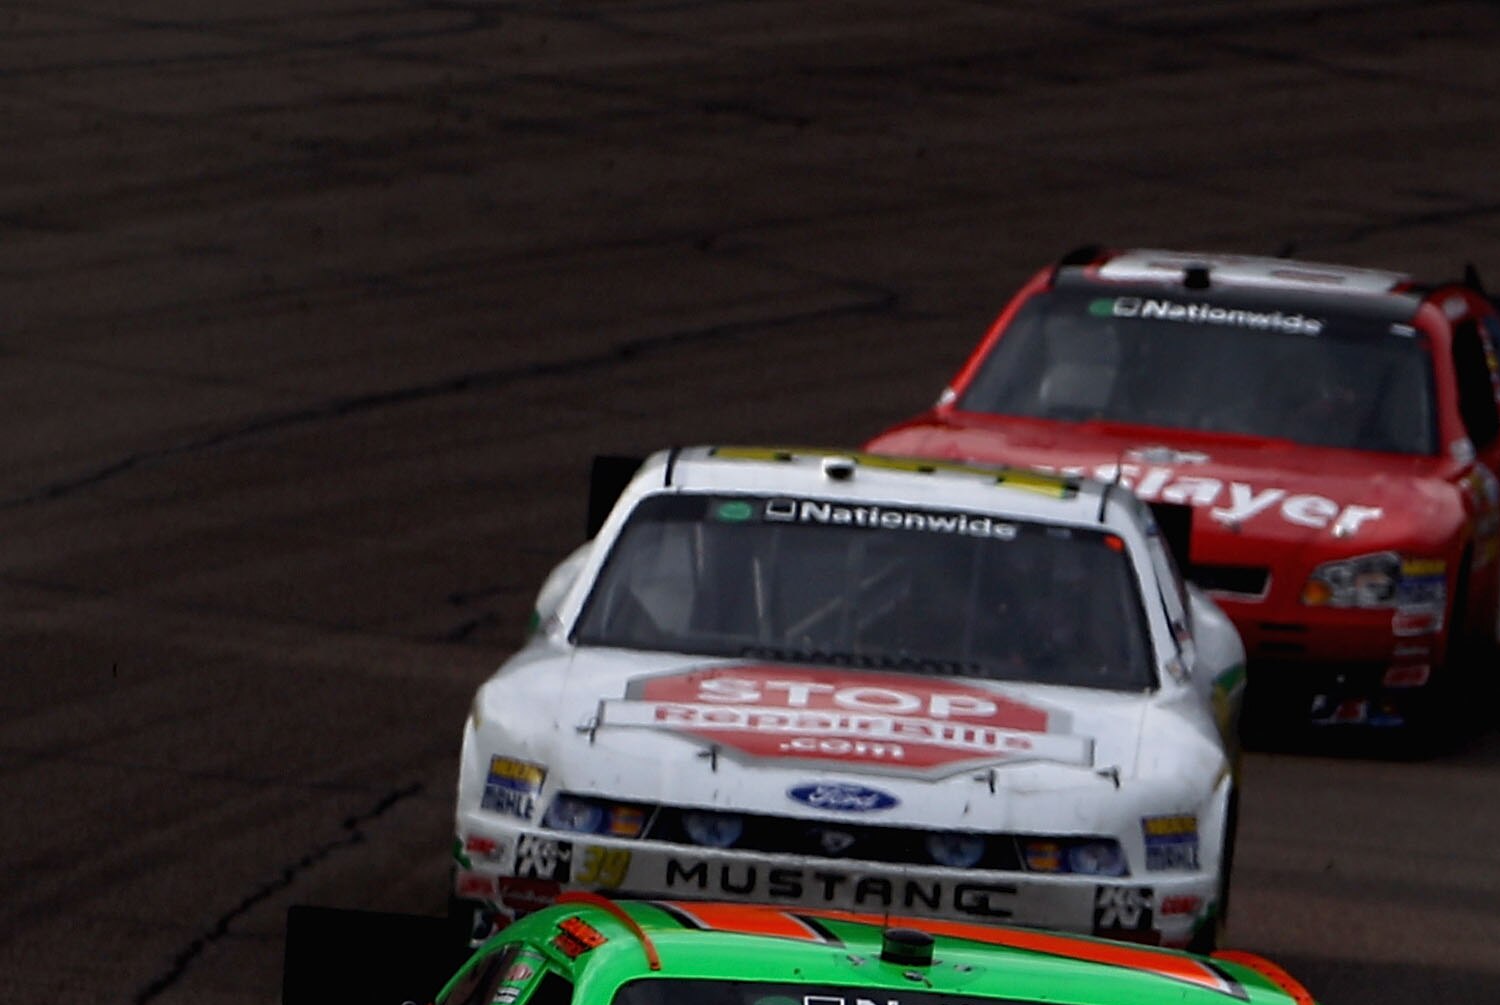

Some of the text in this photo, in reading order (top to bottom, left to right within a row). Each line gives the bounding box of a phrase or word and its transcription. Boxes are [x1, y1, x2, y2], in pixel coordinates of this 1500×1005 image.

[1141, 299, 1323, 336] Nationwide
[802, 500, 1017, 541] Nationwide
[697, 677, 998, 719] STOP
[654, 706, 1034, 751] RepairBills
[779, 736, 904, 760] .com
[576, 846, 632, 889] 39
[666, 860, 1017, 917] MUSTANG
